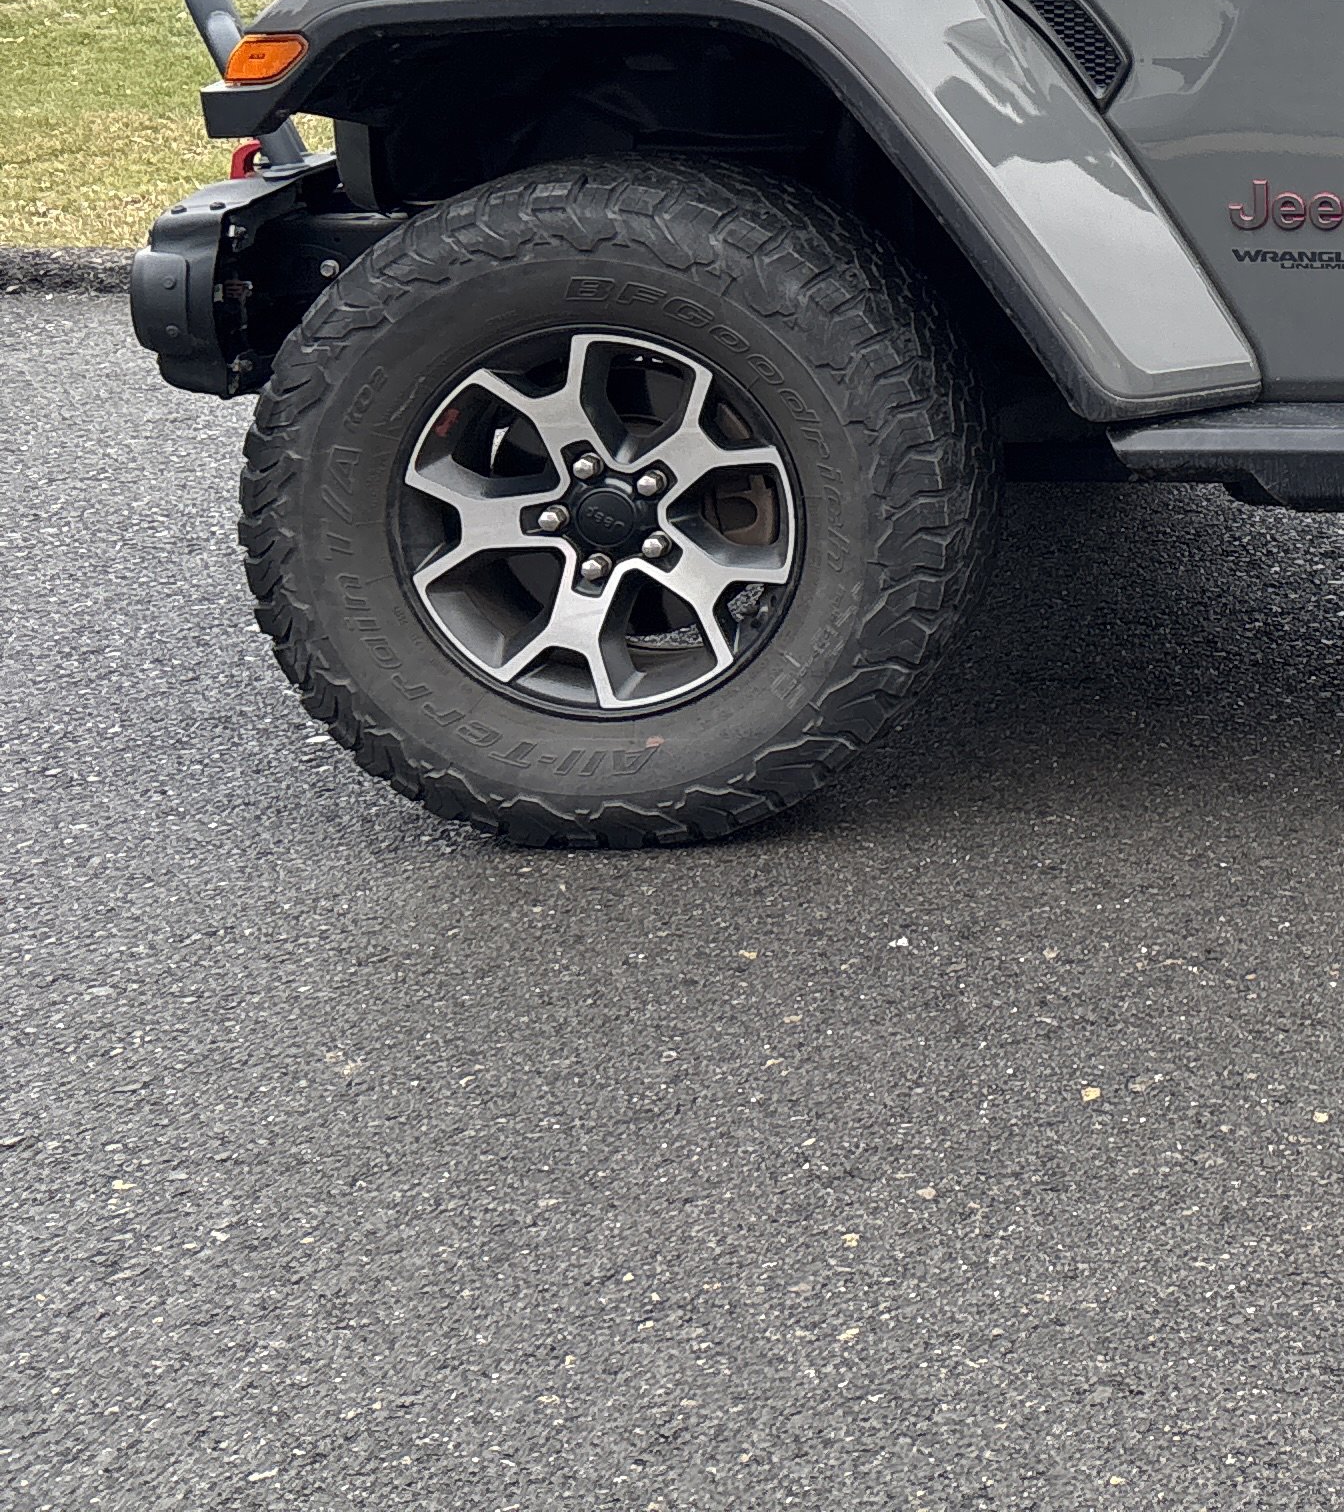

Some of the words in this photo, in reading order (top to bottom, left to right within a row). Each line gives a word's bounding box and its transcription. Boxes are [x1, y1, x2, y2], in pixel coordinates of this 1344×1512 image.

[322, 444, 361, 561] T/A
[564, 276, 850, 573] BFGoodrich
[336, 574, 661, 776] All-Terrain
